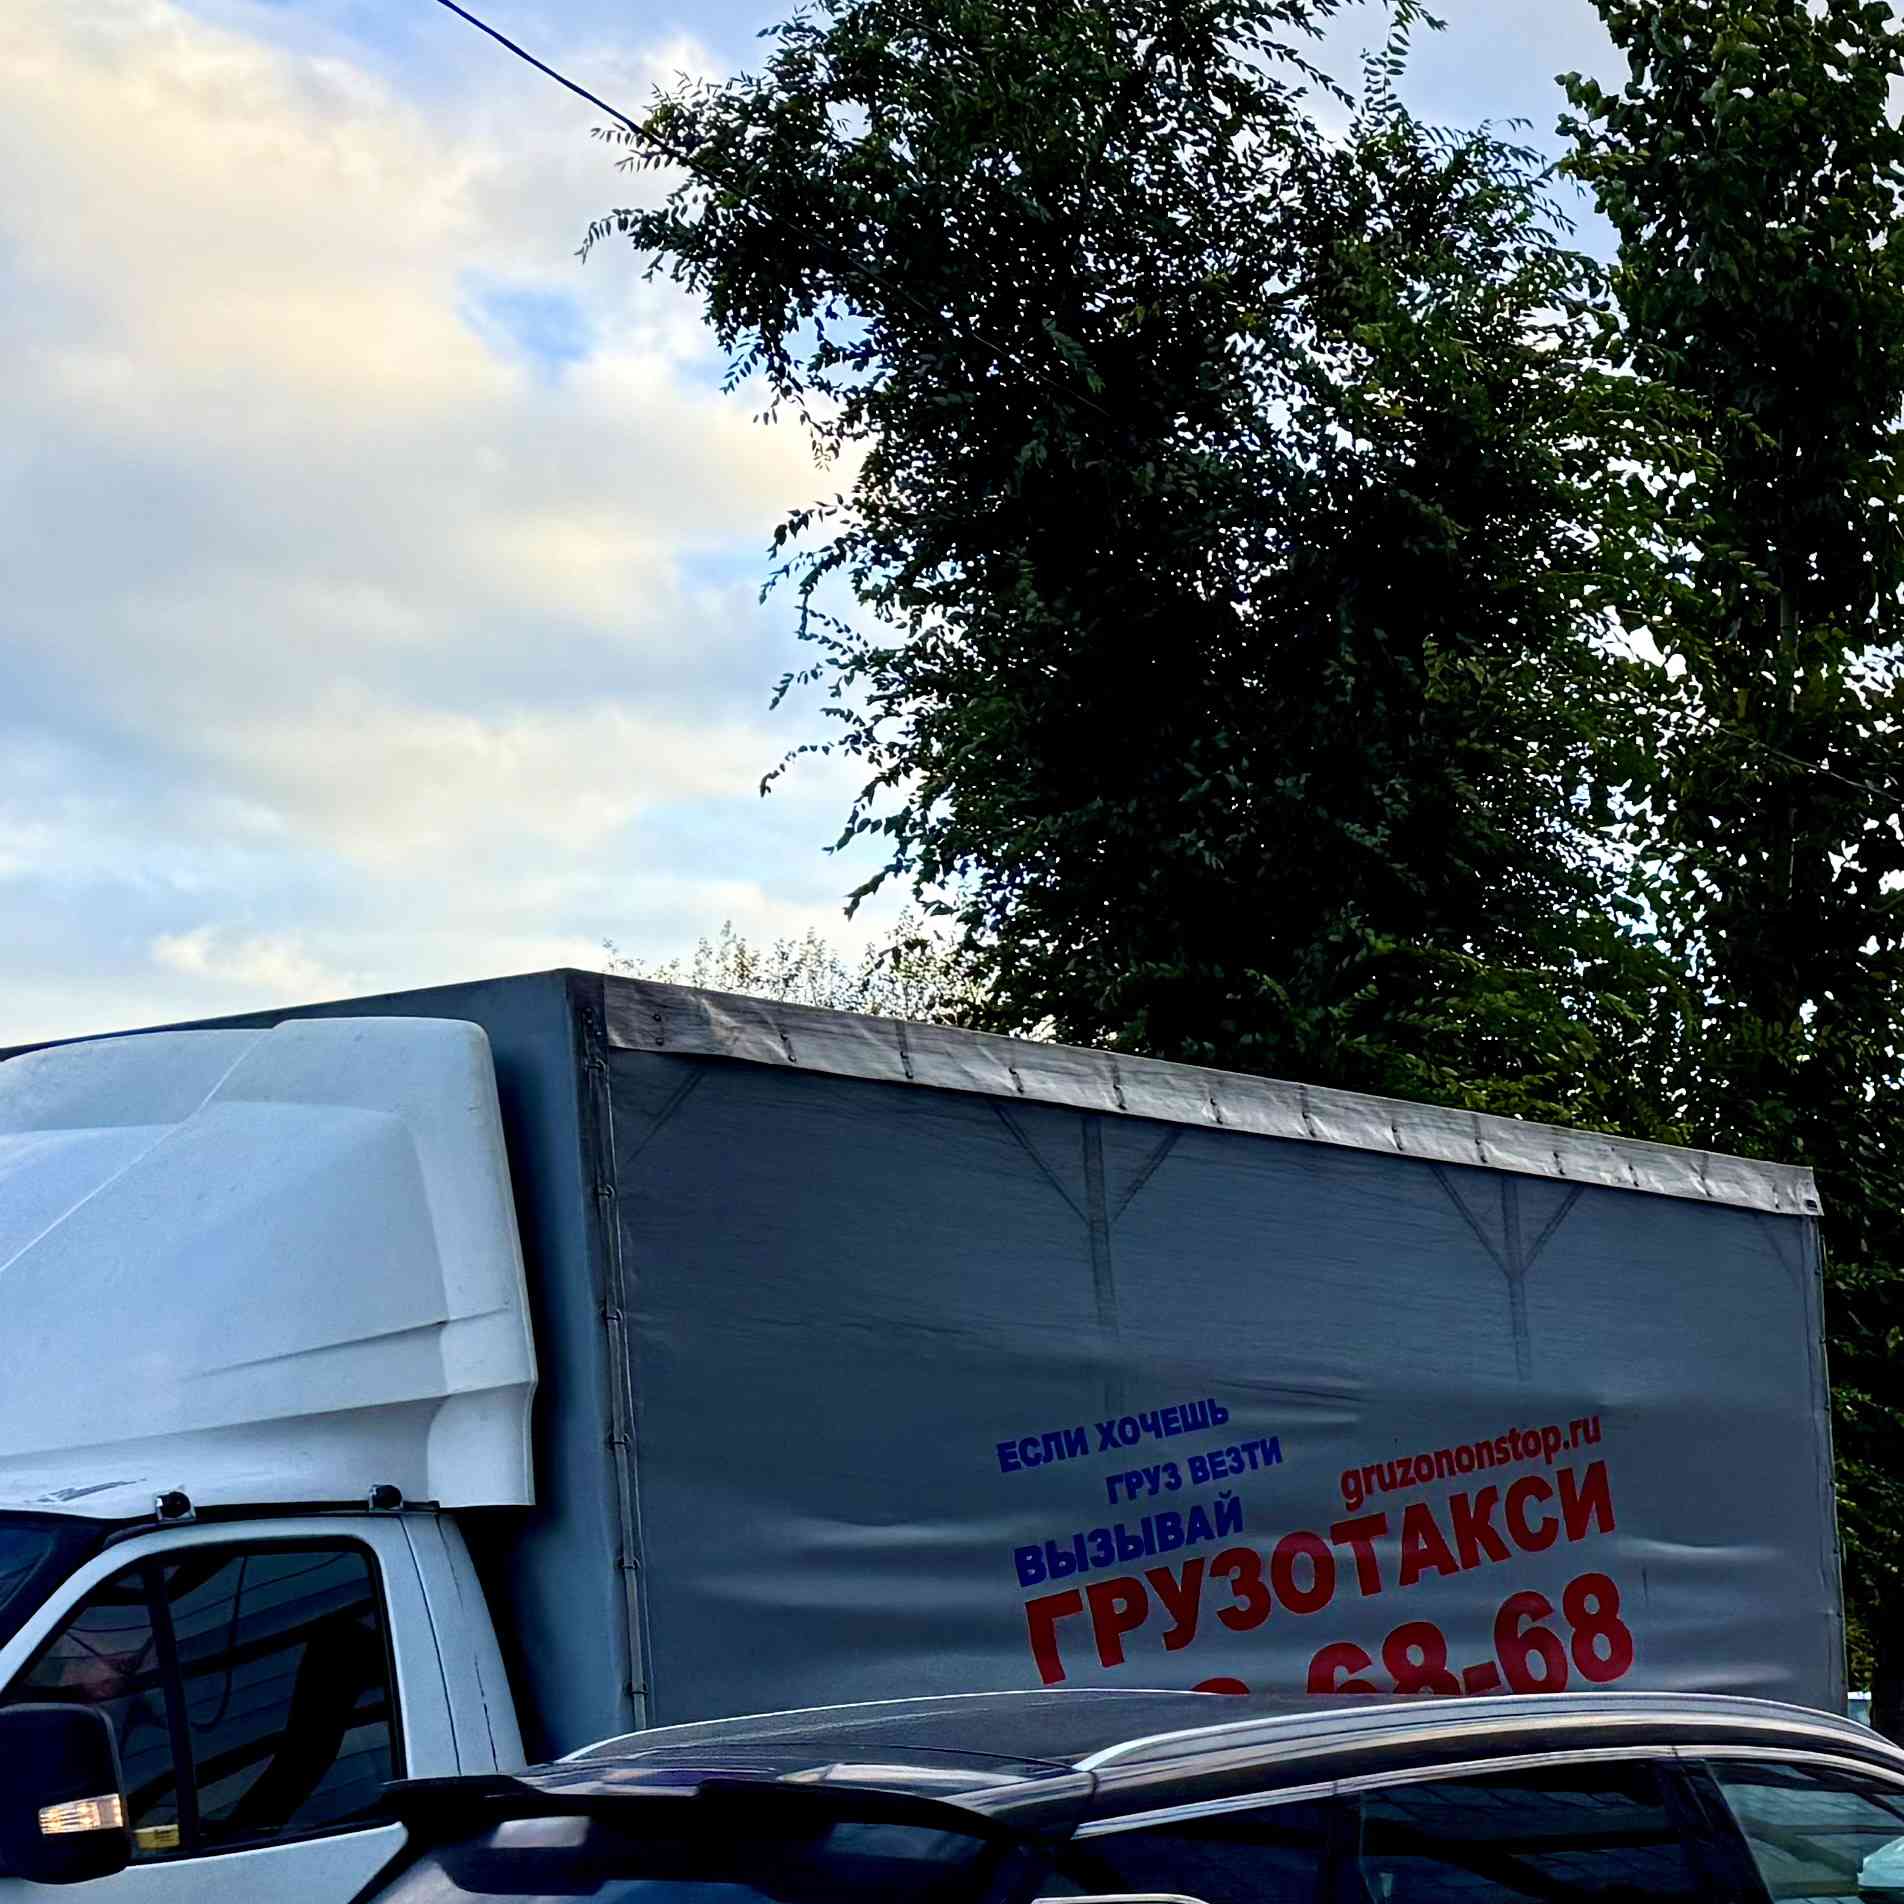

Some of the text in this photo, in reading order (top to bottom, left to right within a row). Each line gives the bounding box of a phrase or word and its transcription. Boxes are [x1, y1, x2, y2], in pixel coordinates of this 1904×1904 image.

[996, 1398, 1230, 1473] ЕСЛИ ХОЧЕШЬ
[1105, 1436, 1284, 1505] ГРУЗ ВЕЗТИ
[1340, 1415, 1602, 1512] gruzononstop.ru
[1013, 1489, 1244, 1588] ВЫЗЫВАЙ
[1024, 1459, 1617, 1684] ГРУЗОТАКСИ
